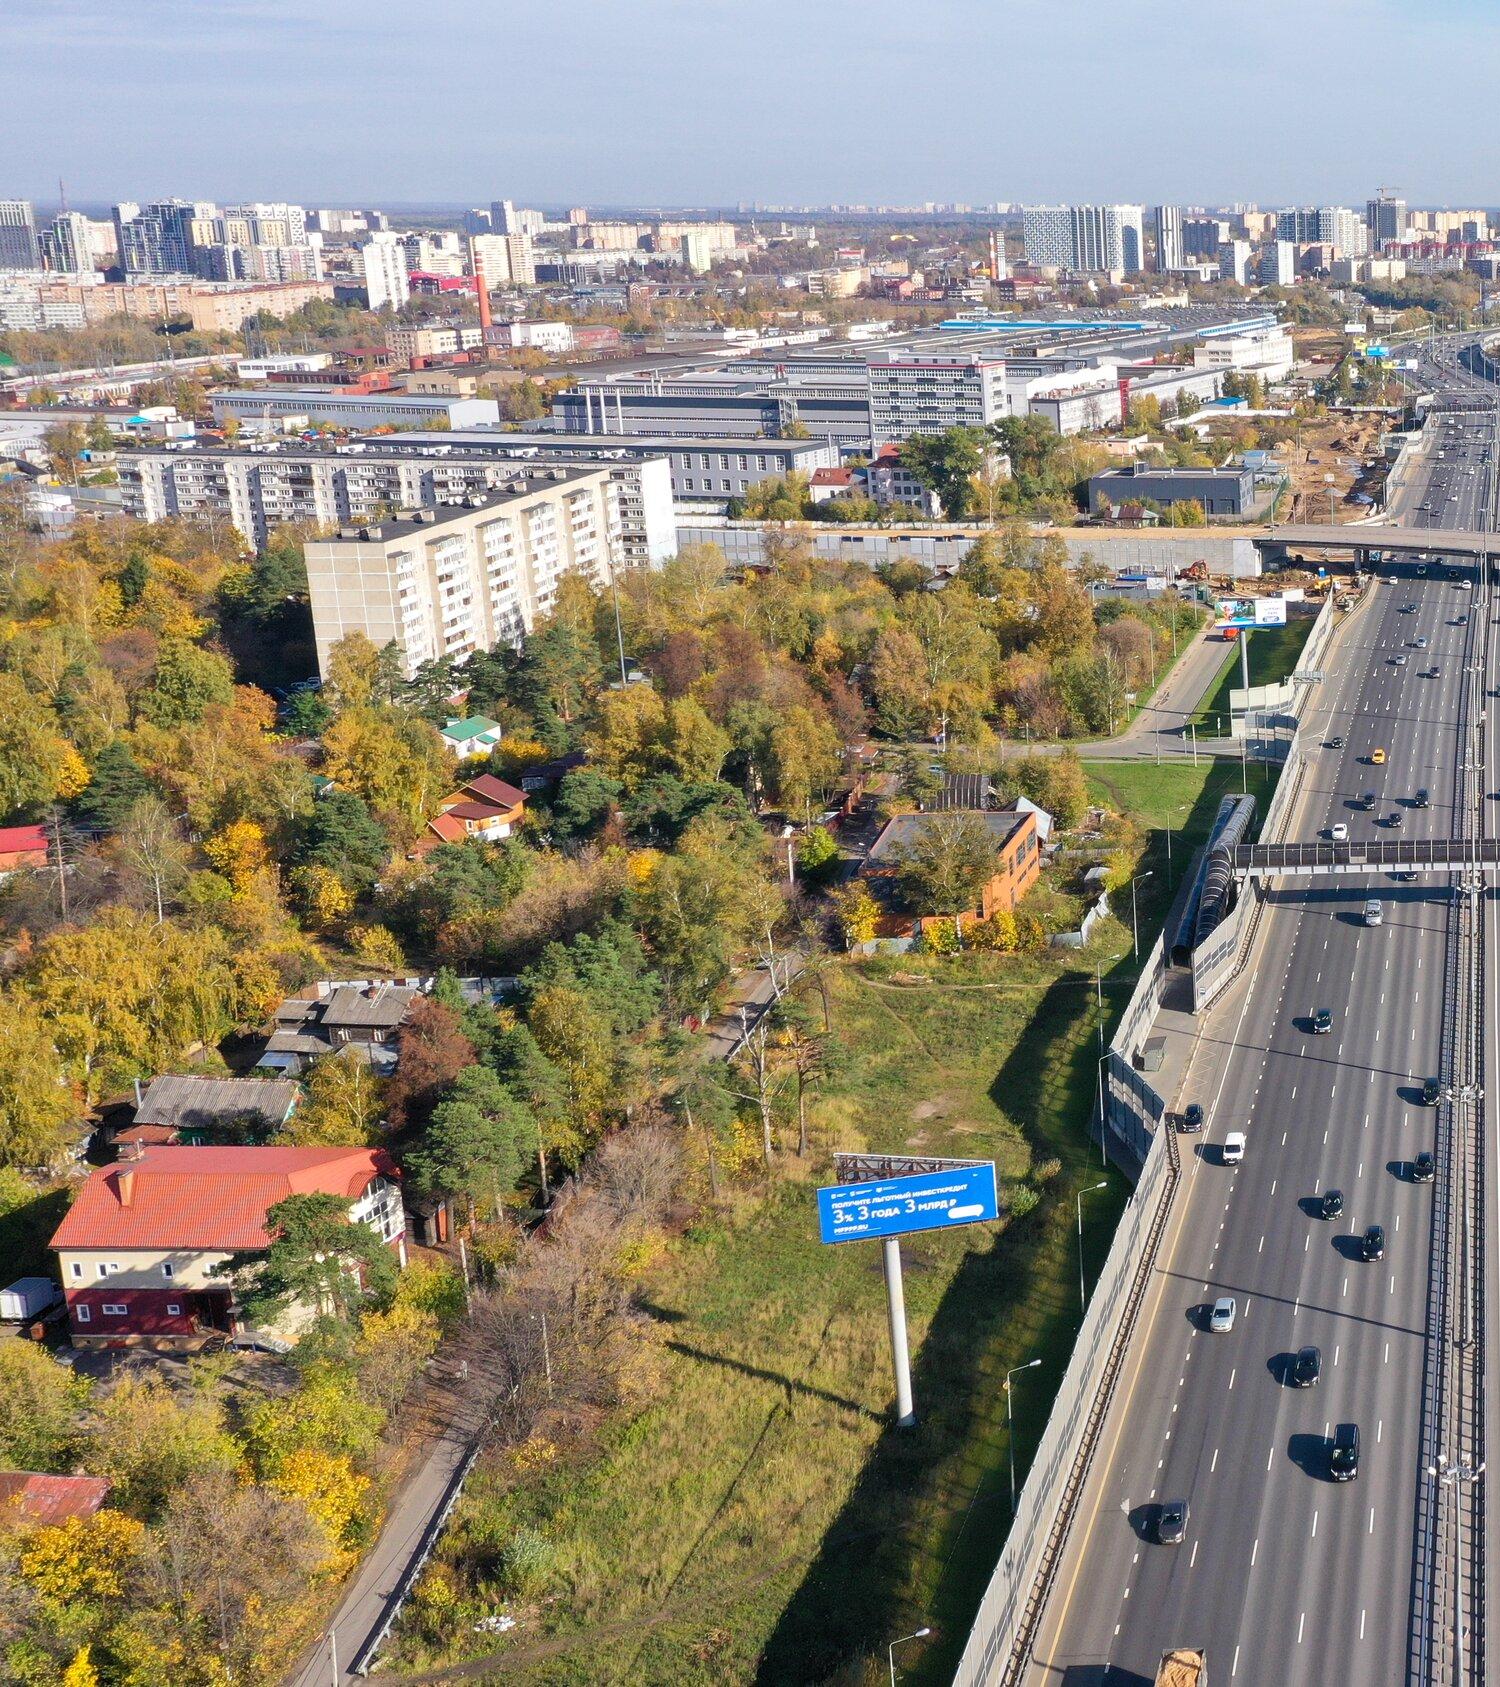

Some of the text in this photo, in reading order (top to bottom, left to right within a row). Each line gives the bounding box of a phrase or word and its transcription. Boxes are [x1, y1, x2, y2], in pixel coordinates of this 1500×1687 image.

[832, 1198, 871, 1209] ПОЛУЧИТЕ
[872, 1191, 911, 1204] ЛЬГОТНЫЙ
[912, 1184, 968, 1198] ИНВЕСТКРЕДИТ
[833, 1209, 854, 1224] 3%
[857, 1206, 869, 1220] 3
[871, 1207, 900, 1218] ГОДА
[904, 1199, 916, 1213] 3
[918, 1201, 948, 1211] МЛРД
